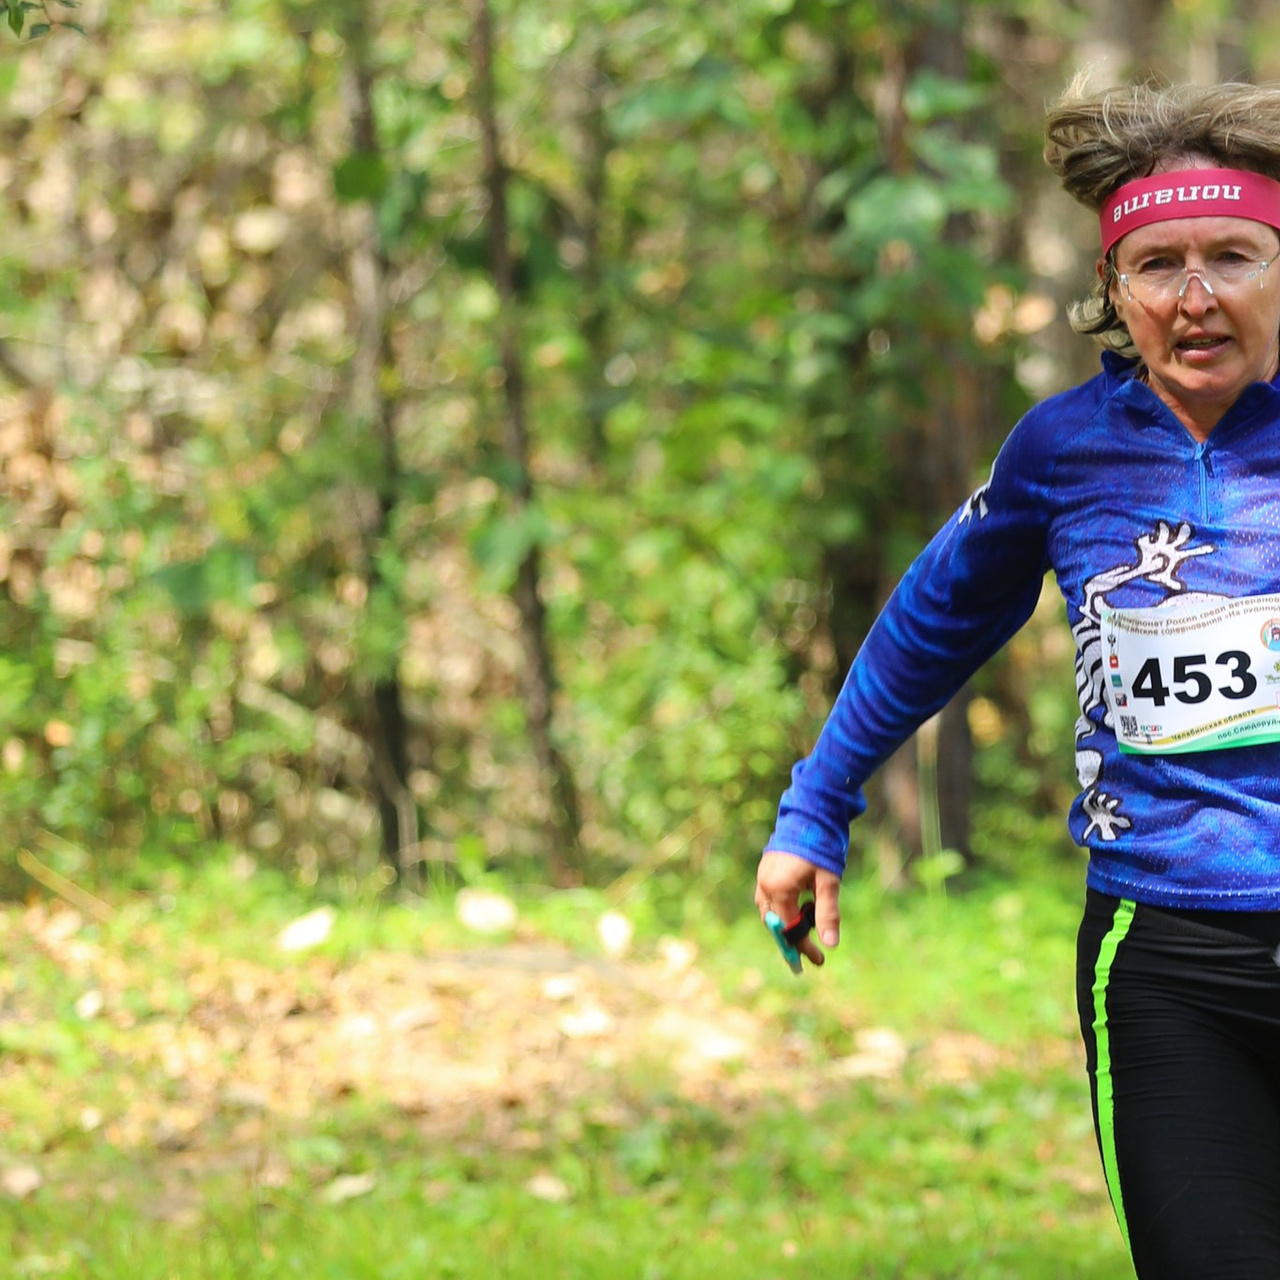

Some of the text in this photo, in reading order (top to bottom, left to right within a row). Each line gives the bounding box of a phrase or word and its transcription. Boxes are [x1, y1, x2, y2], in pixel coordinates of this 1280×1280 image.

[1113, 184, 1242, 223] noname
[1161, 617, 1223, 636] соревнования
[1165, 615, 1198, 627] России
[1200, 606, 1226, 619] среди
[1228, 597, 1280, 609] ветеранов
[1131, 650, 1257, 707] 453
[1171, 720, 1223, 741] Челябинская
[1223, 708, 1256, 724] область
